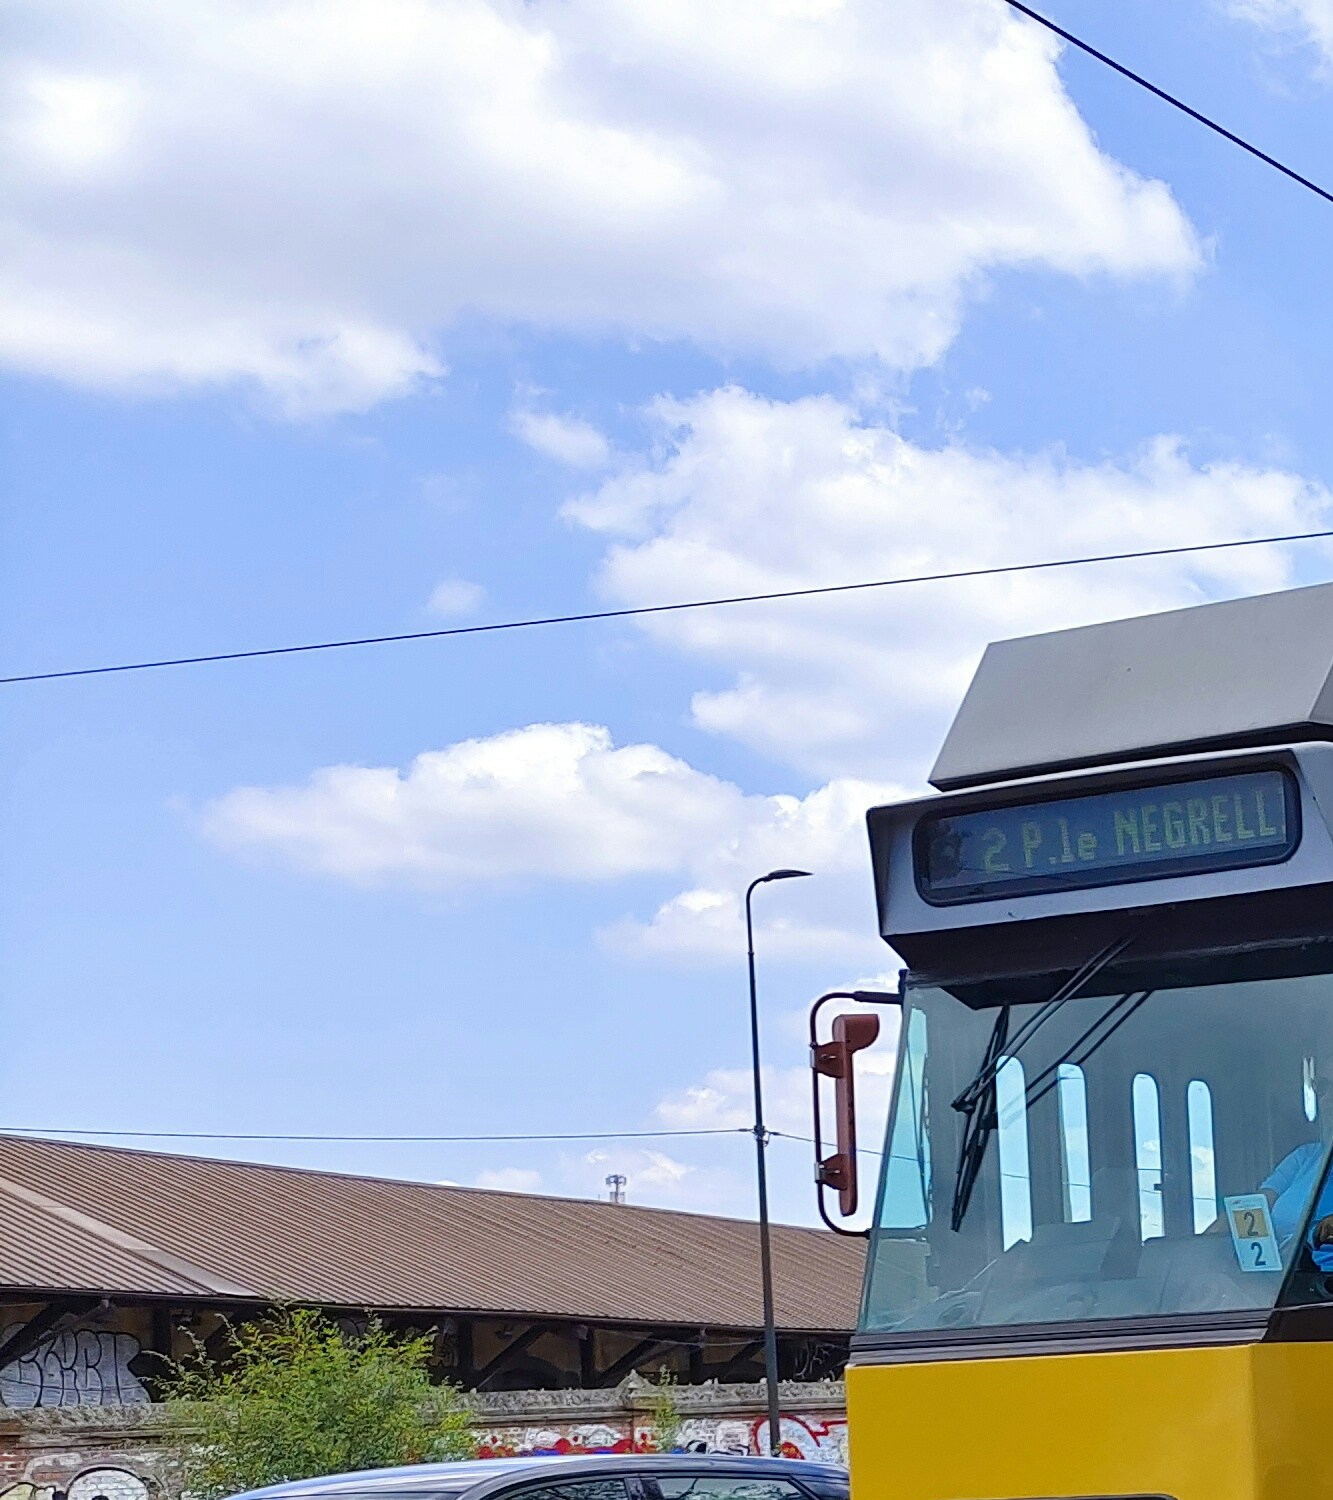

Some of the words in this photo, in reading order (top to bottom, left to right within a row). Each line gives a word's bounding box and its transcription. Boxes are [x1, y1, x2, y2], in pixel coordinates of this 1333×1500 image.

[982, 828, 1010, 873] 2
[1113, 791, 1285, 856] NEGRELL
[1243, 1211, 1259, 1237] 2
[1250, 1241, 1267, 1267] 2
